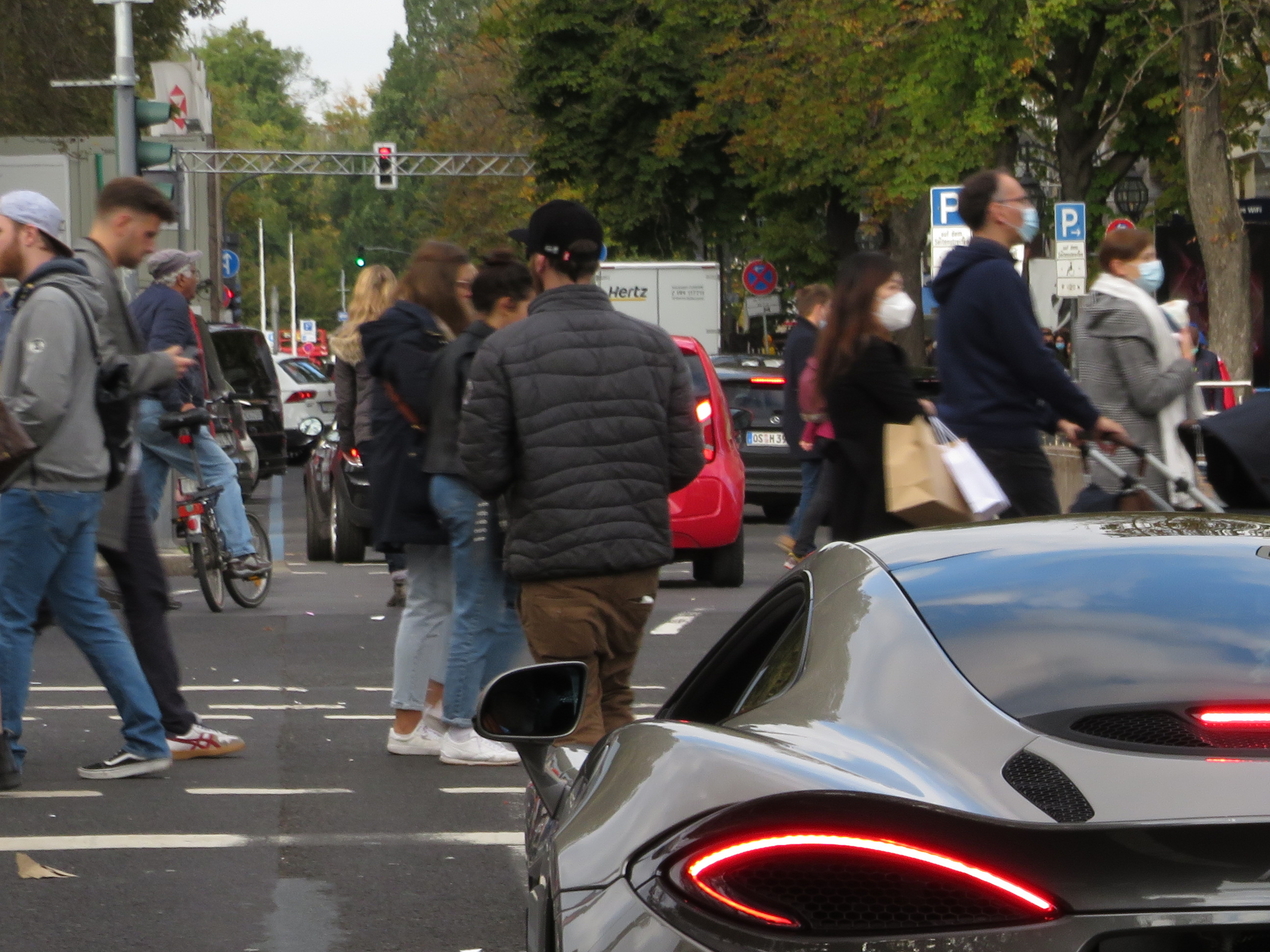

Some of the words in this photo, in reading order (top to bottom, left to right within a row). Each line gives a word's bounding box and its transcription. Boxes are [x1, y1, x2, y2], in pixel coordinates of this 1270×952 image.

[941, 191, 959, 225] P
[1062, 208, 1078, 238] P
[608, 286, 648, 298] Hertz
[753, 434, 763, 443] OS
[769, 434, 775, 443] H
